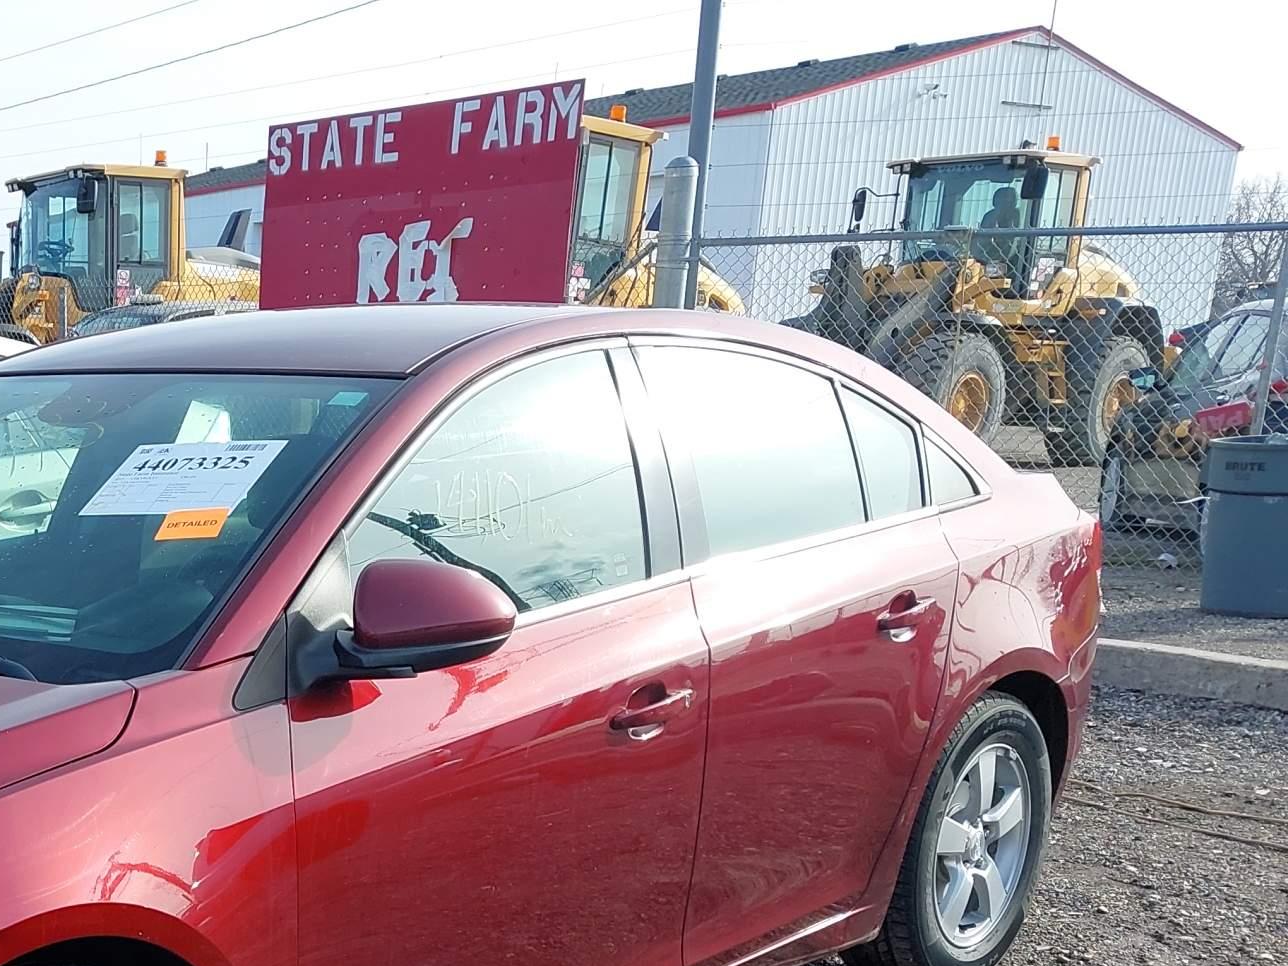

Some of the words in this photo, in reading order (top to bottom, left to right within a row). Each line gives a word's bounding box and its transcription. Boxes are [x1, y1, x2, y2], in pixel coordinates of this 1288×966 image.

[269, 112, 402, 176] STATE
[450, 83, 582, 154] FARM
[132, 455, 256, 472] 44073325
[1225, 461, 1266, 472] BRUTE
[166, 519, 218, 529] DETAILED
